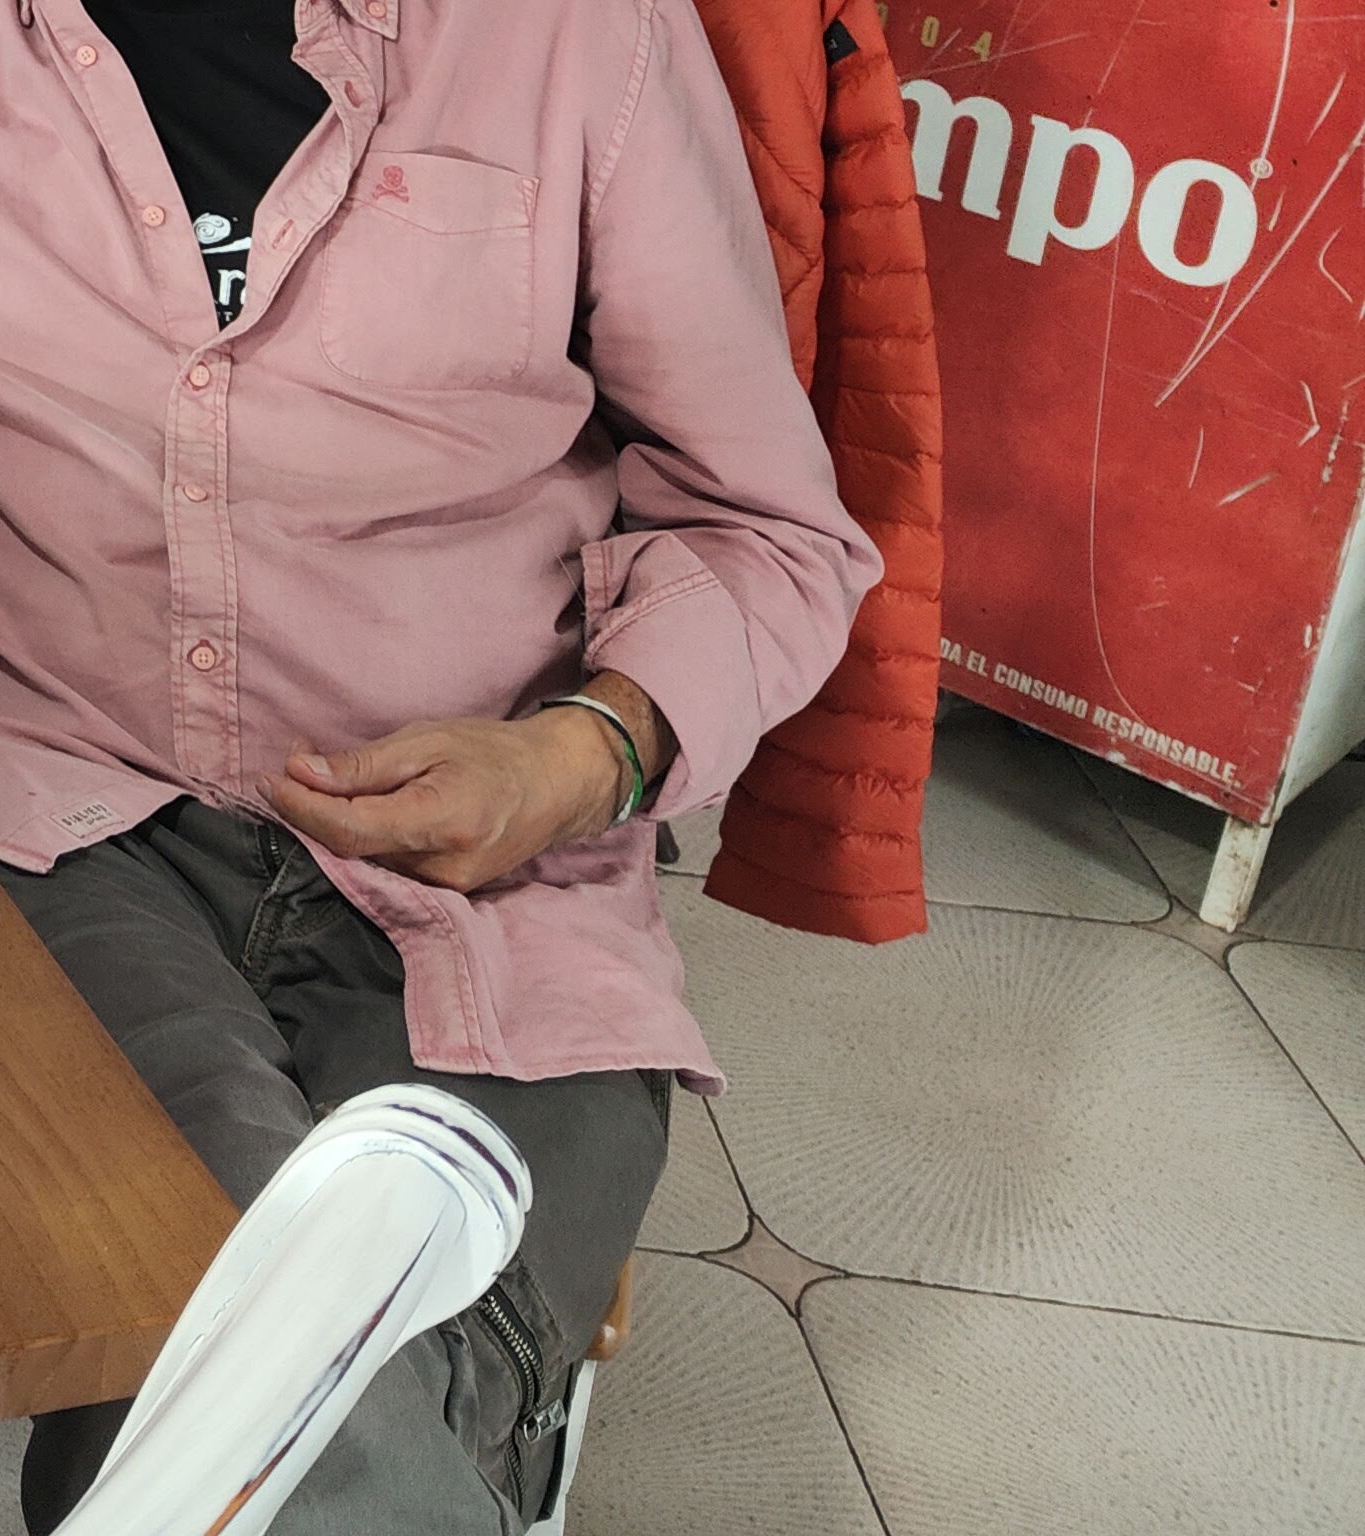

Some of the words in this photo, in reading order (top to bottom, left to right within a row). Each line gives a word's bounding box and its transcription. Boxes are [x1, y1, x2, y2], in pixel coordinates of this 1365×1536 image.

[966, 650, 988, 678] EL
[993, 662, 1088, 720] CONSUMO
[1092, 705, 1242, 788] RESPONSABLE.
